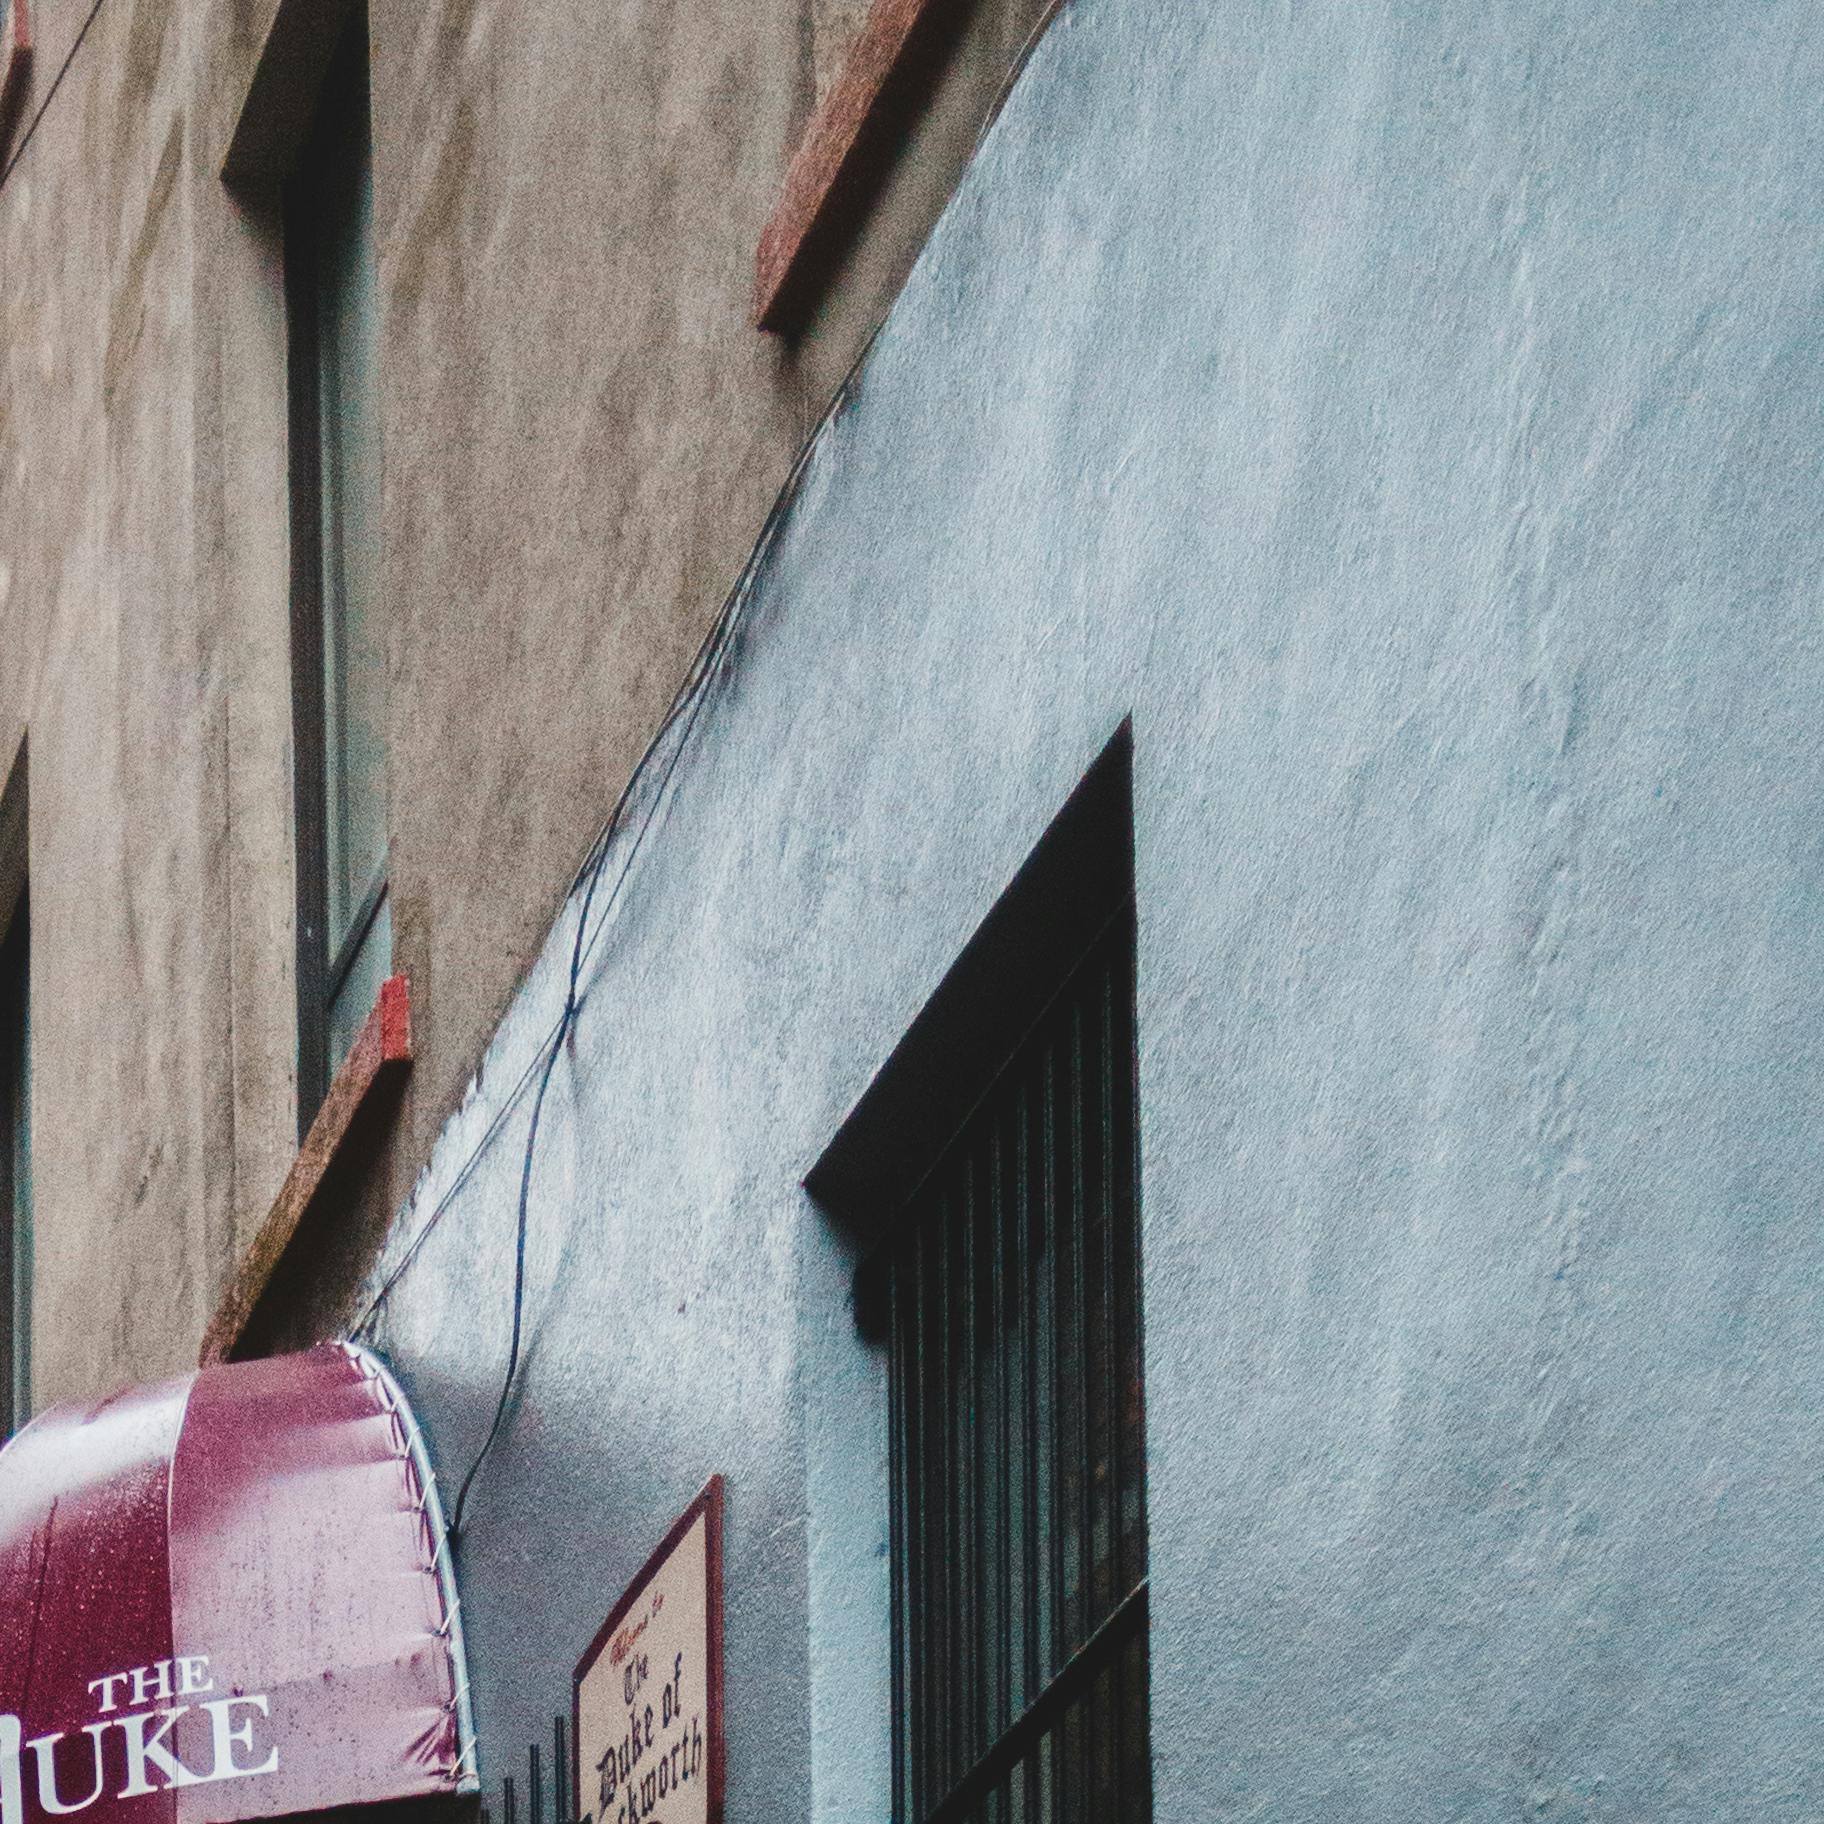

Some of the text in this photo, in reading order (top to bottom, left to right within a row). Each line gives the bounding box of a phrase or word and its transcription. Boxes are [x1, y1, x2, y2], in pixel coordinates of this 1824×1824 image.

[87, 1654, 214, 1714] THE
[624, 1651, 649, 1706] The
[595, 1651, 683, 1822] Duke of
